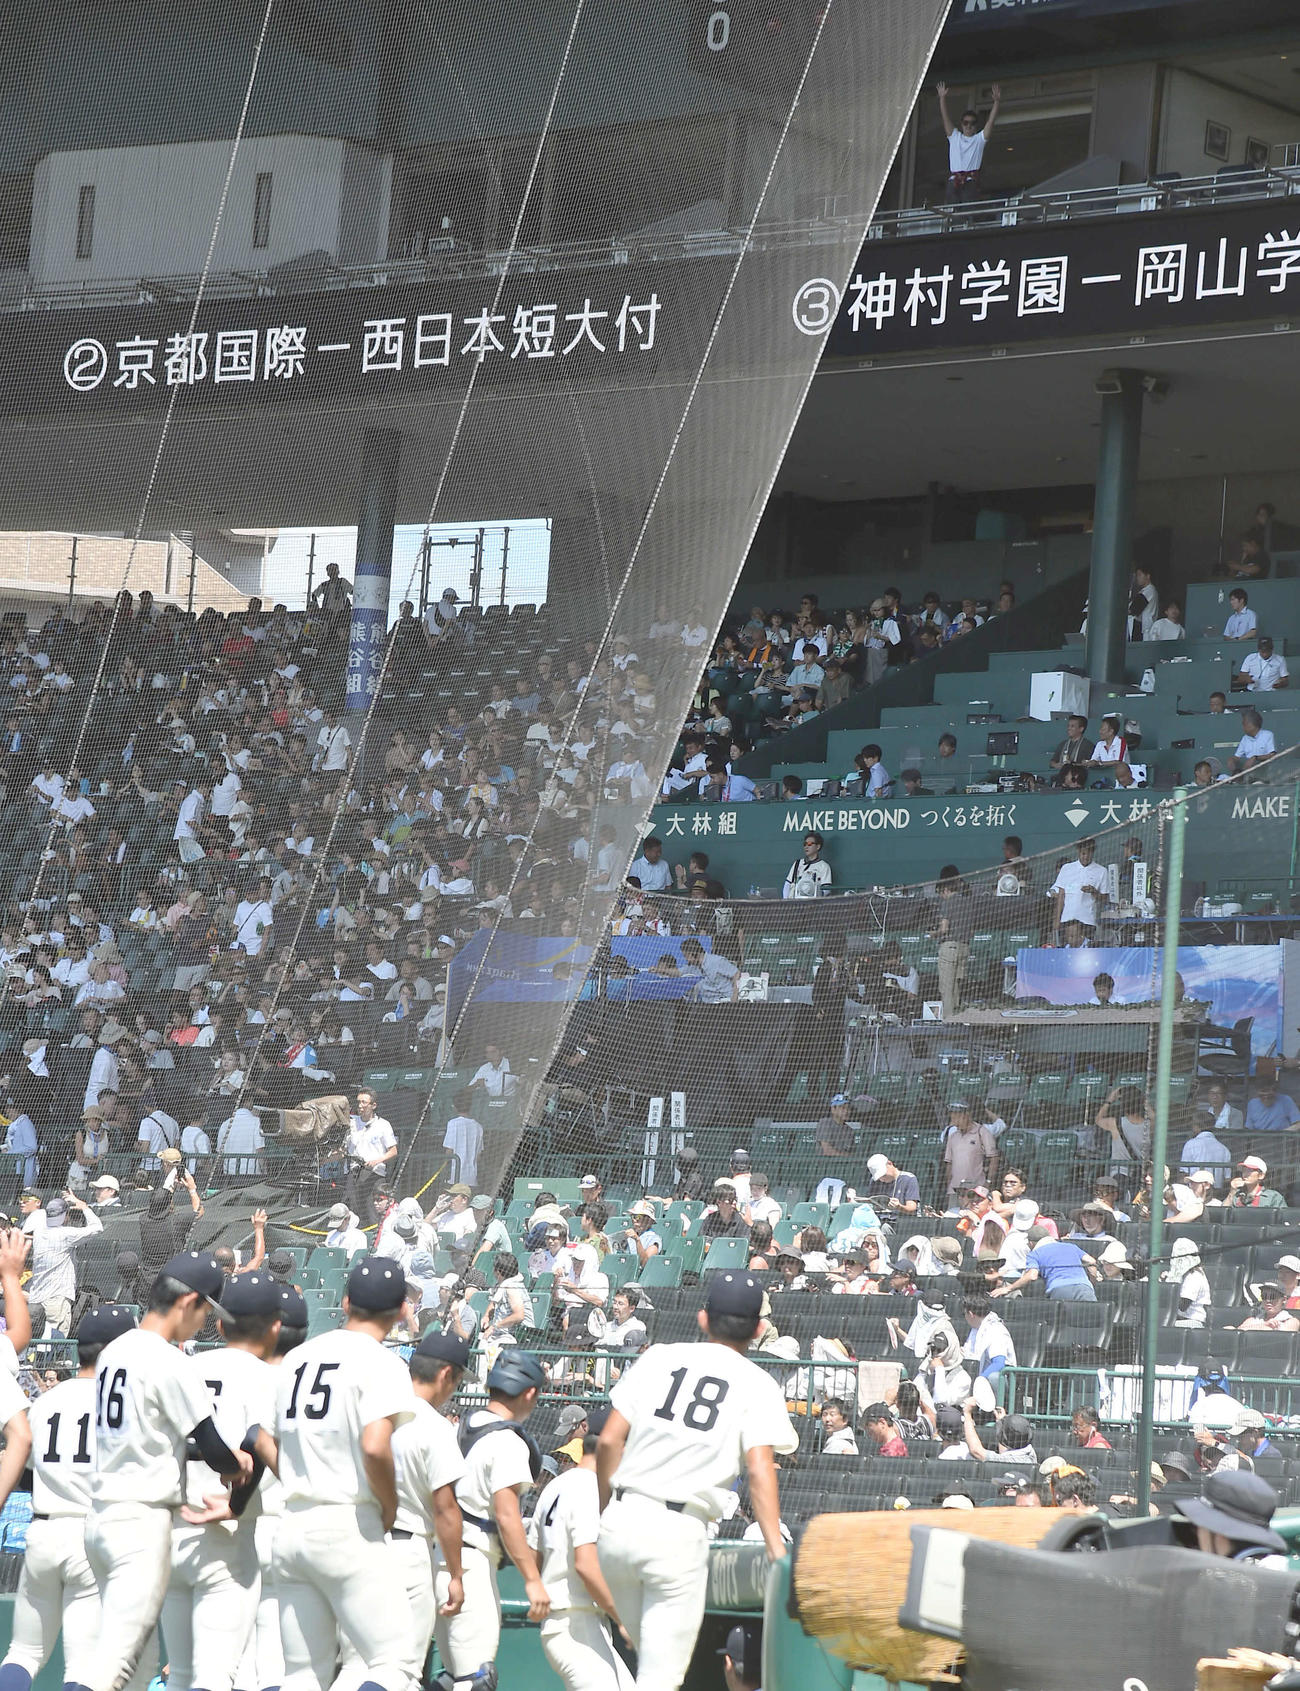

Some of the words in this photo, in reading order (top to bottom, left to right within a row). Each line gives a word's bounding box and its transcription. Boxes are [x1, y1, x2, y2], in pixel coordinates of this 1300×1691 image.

[665, 811, 737, 837] 大林組
[783, 810, 834, 832] MAKE
[838, 808, 911, 830] BEYOND
[920, 806, 1017, 829] つくるを拓く
[1231, 796, 1291, 819] MAKE
[286, 1361, 341, 1420] 15
[653, 1366, 730, 1432] 18
[43, 1412, 91, 1463] 11
